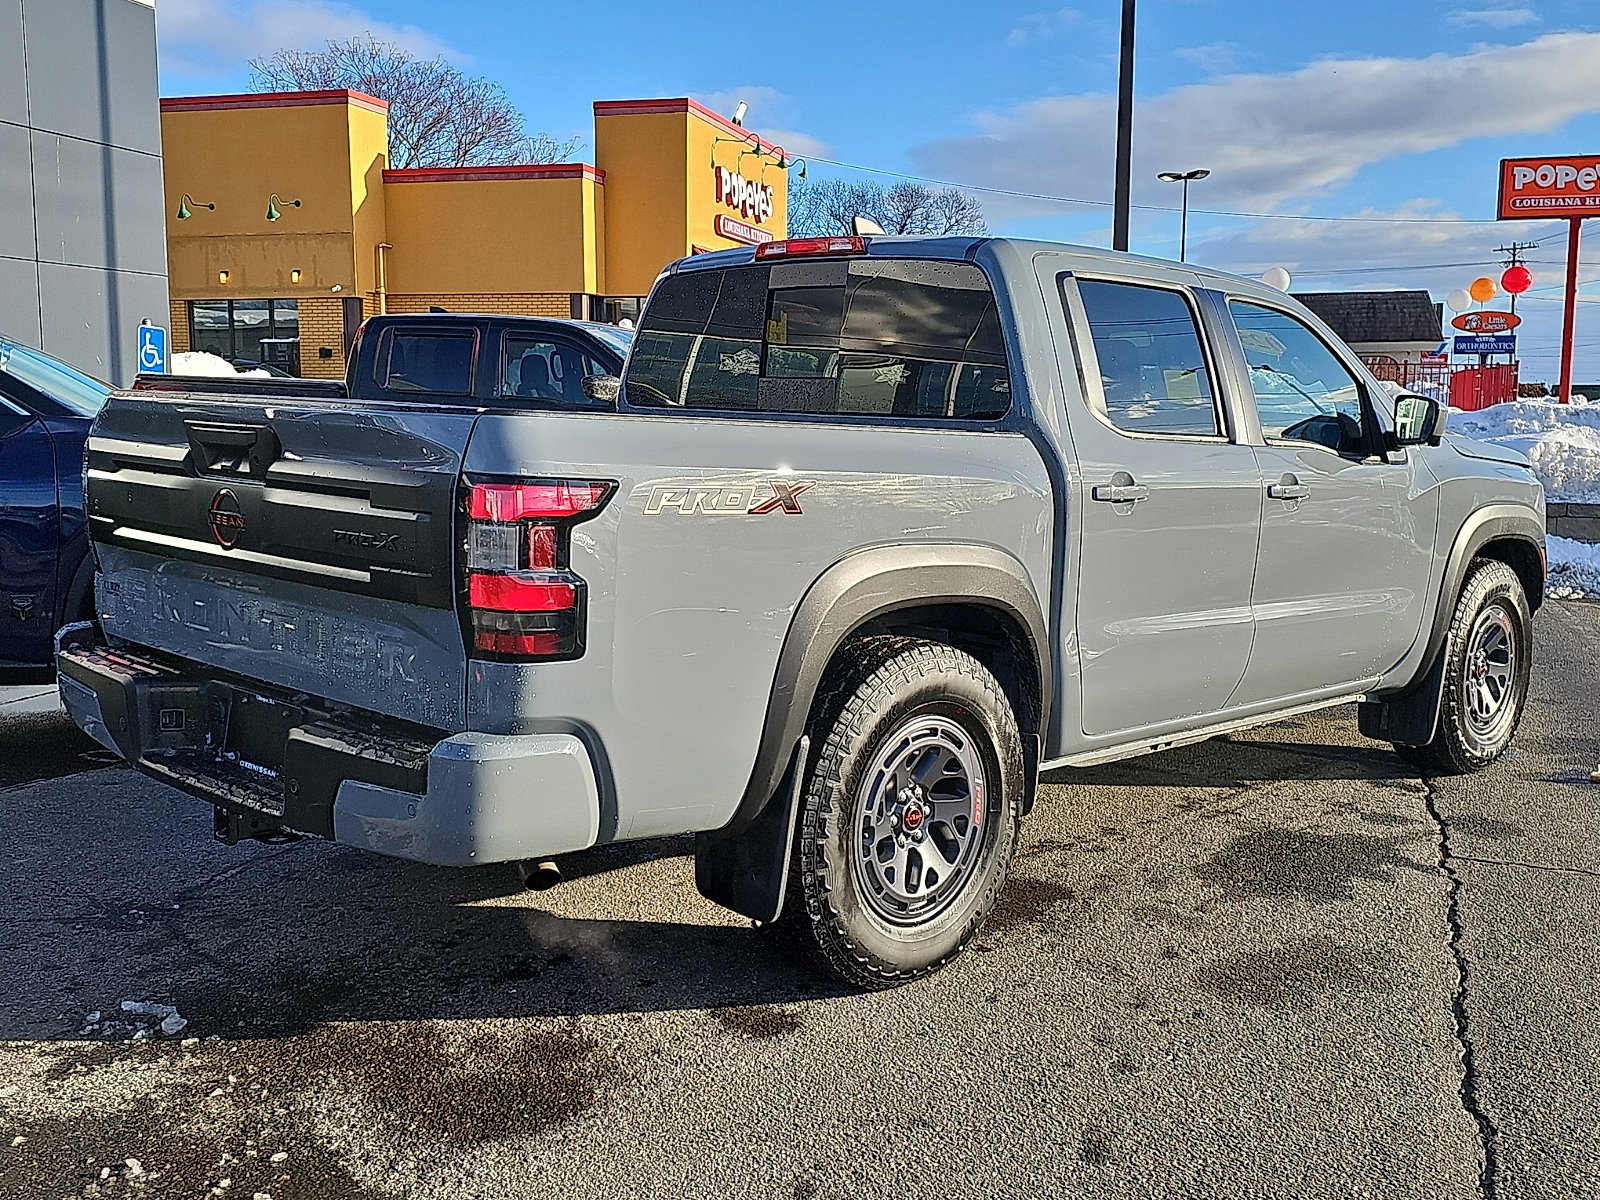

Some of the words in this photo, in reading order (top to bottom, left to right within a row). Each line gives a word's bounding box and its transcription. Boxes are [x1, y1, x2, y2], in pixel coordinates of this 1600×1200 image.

[1515, 198, 1582, 207] LOUISIANA
[1483, 322, 1508, 330] Caesars
[1456, 342, 1515, 350] ORTHODONTICS
